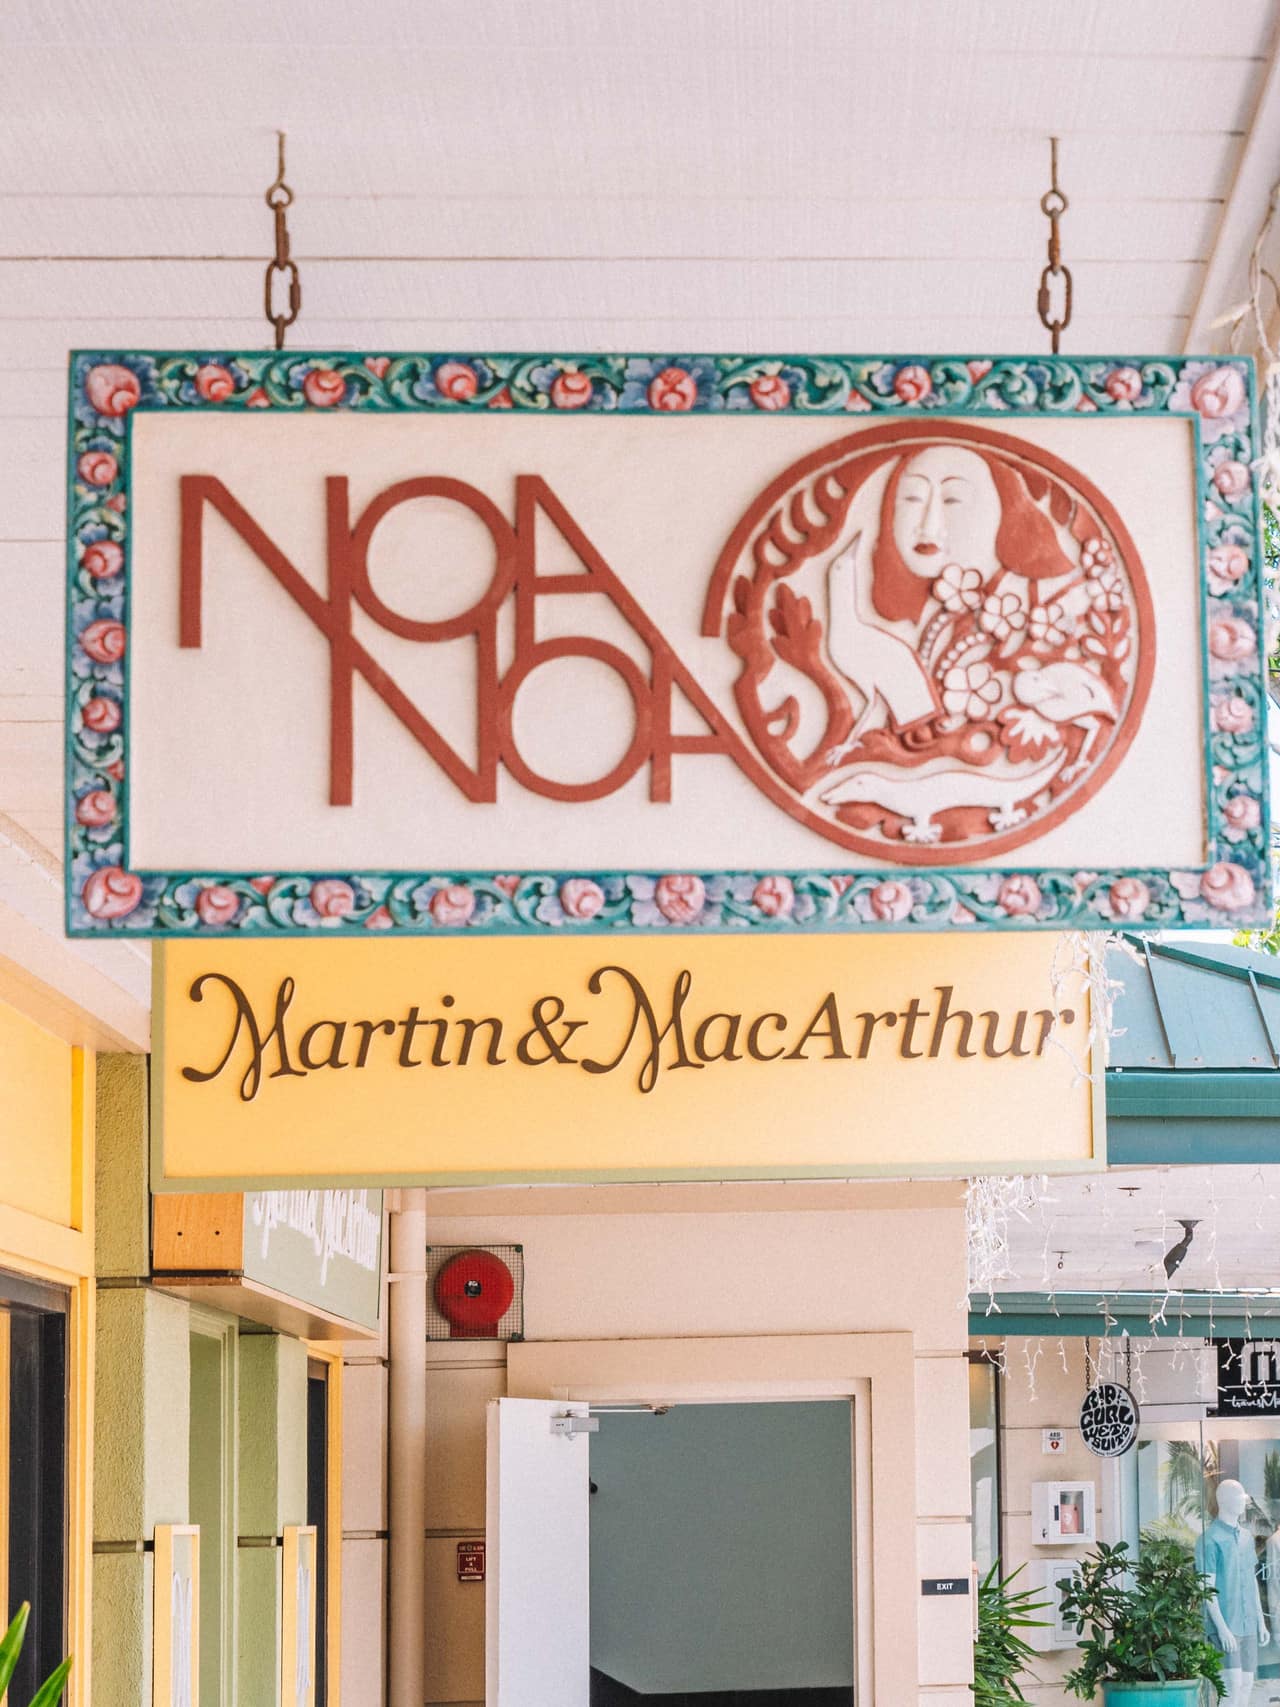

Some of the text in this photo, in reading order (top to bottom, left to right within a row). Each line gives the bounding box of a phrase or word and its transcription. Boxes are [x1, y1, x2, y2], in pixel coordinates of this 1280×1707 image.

[179, 474, 665, 659] NOA
[330, 634, 745, 806] NOA
[182, 965, 1075, 1102] Martin & MacArthur
[1080, 1405, 1134, 1430] CURL
[936, 1582, 954, 1591] EXIT
